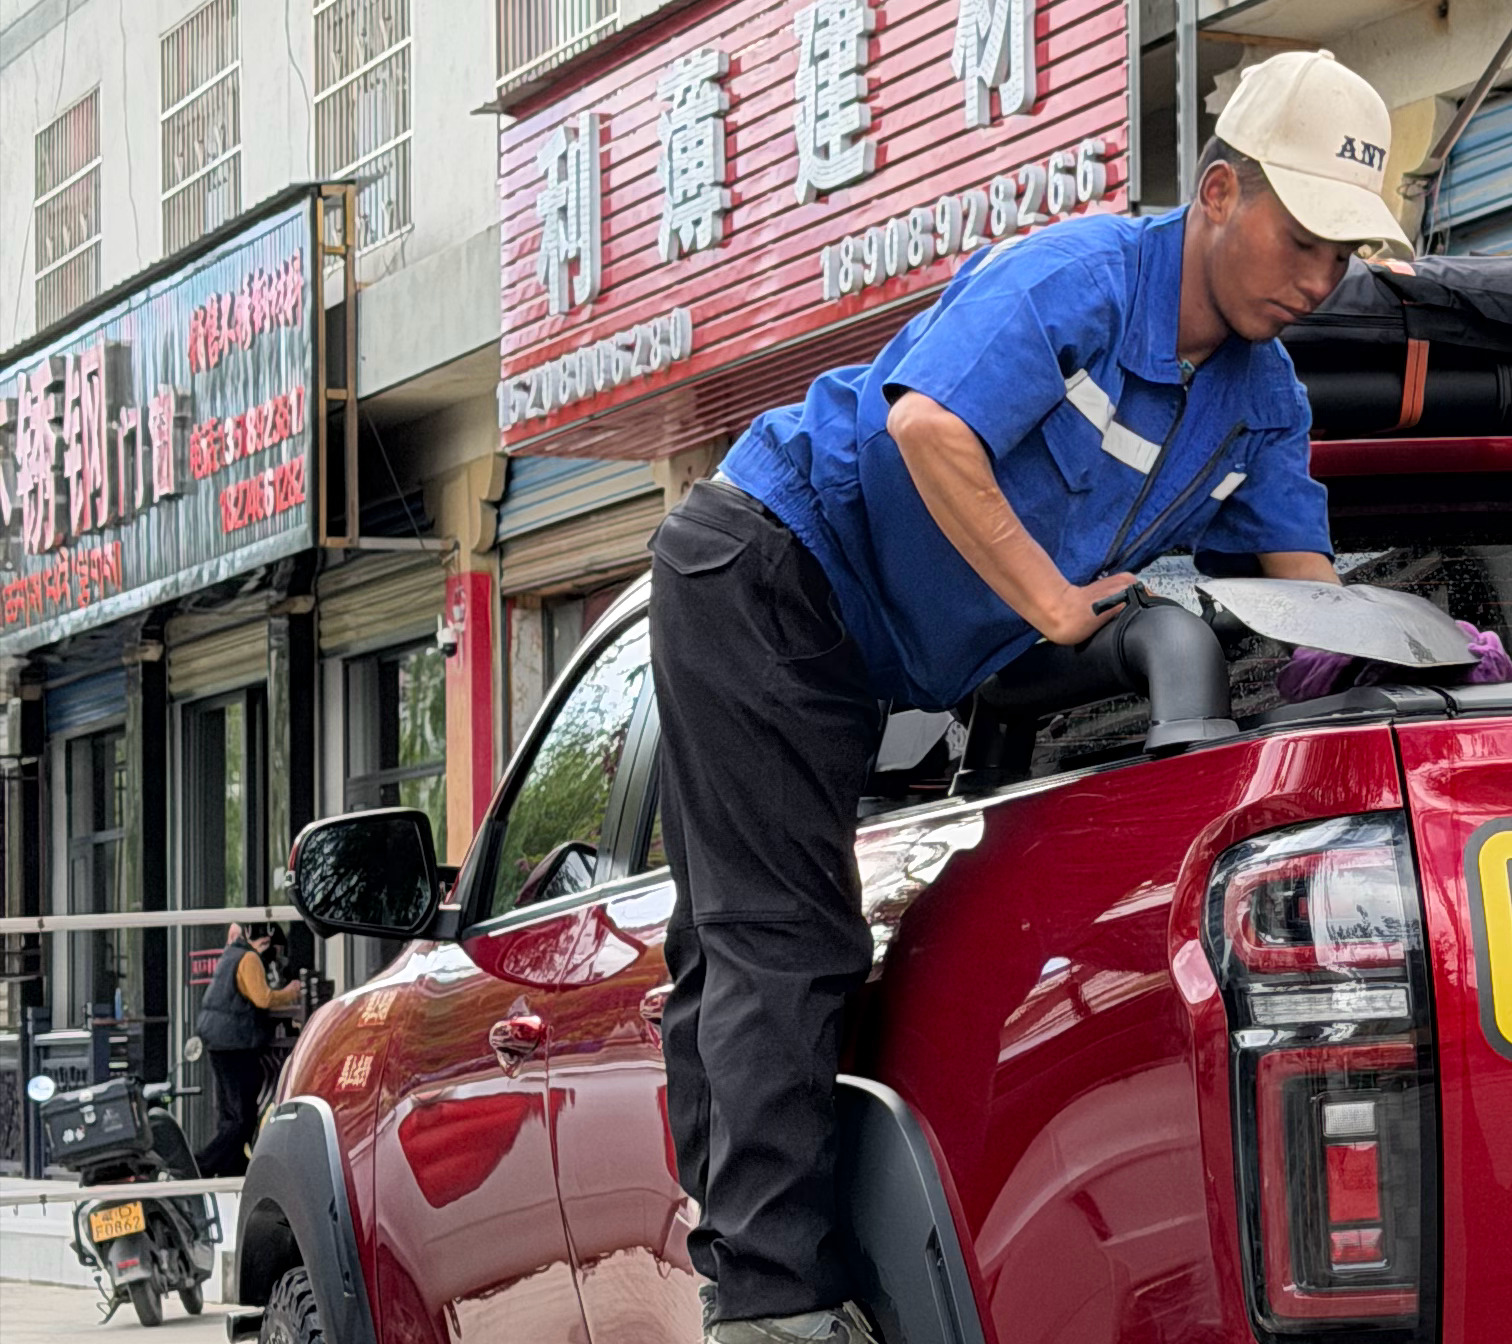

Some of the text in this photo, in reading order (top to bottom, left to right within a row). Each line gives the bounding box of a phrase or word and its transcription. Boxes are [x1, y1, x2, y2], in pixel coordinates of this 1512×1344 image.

[820, 138, 1107, 302] 18908928266
[0, 337, 176, 555] 锈钢门窗
